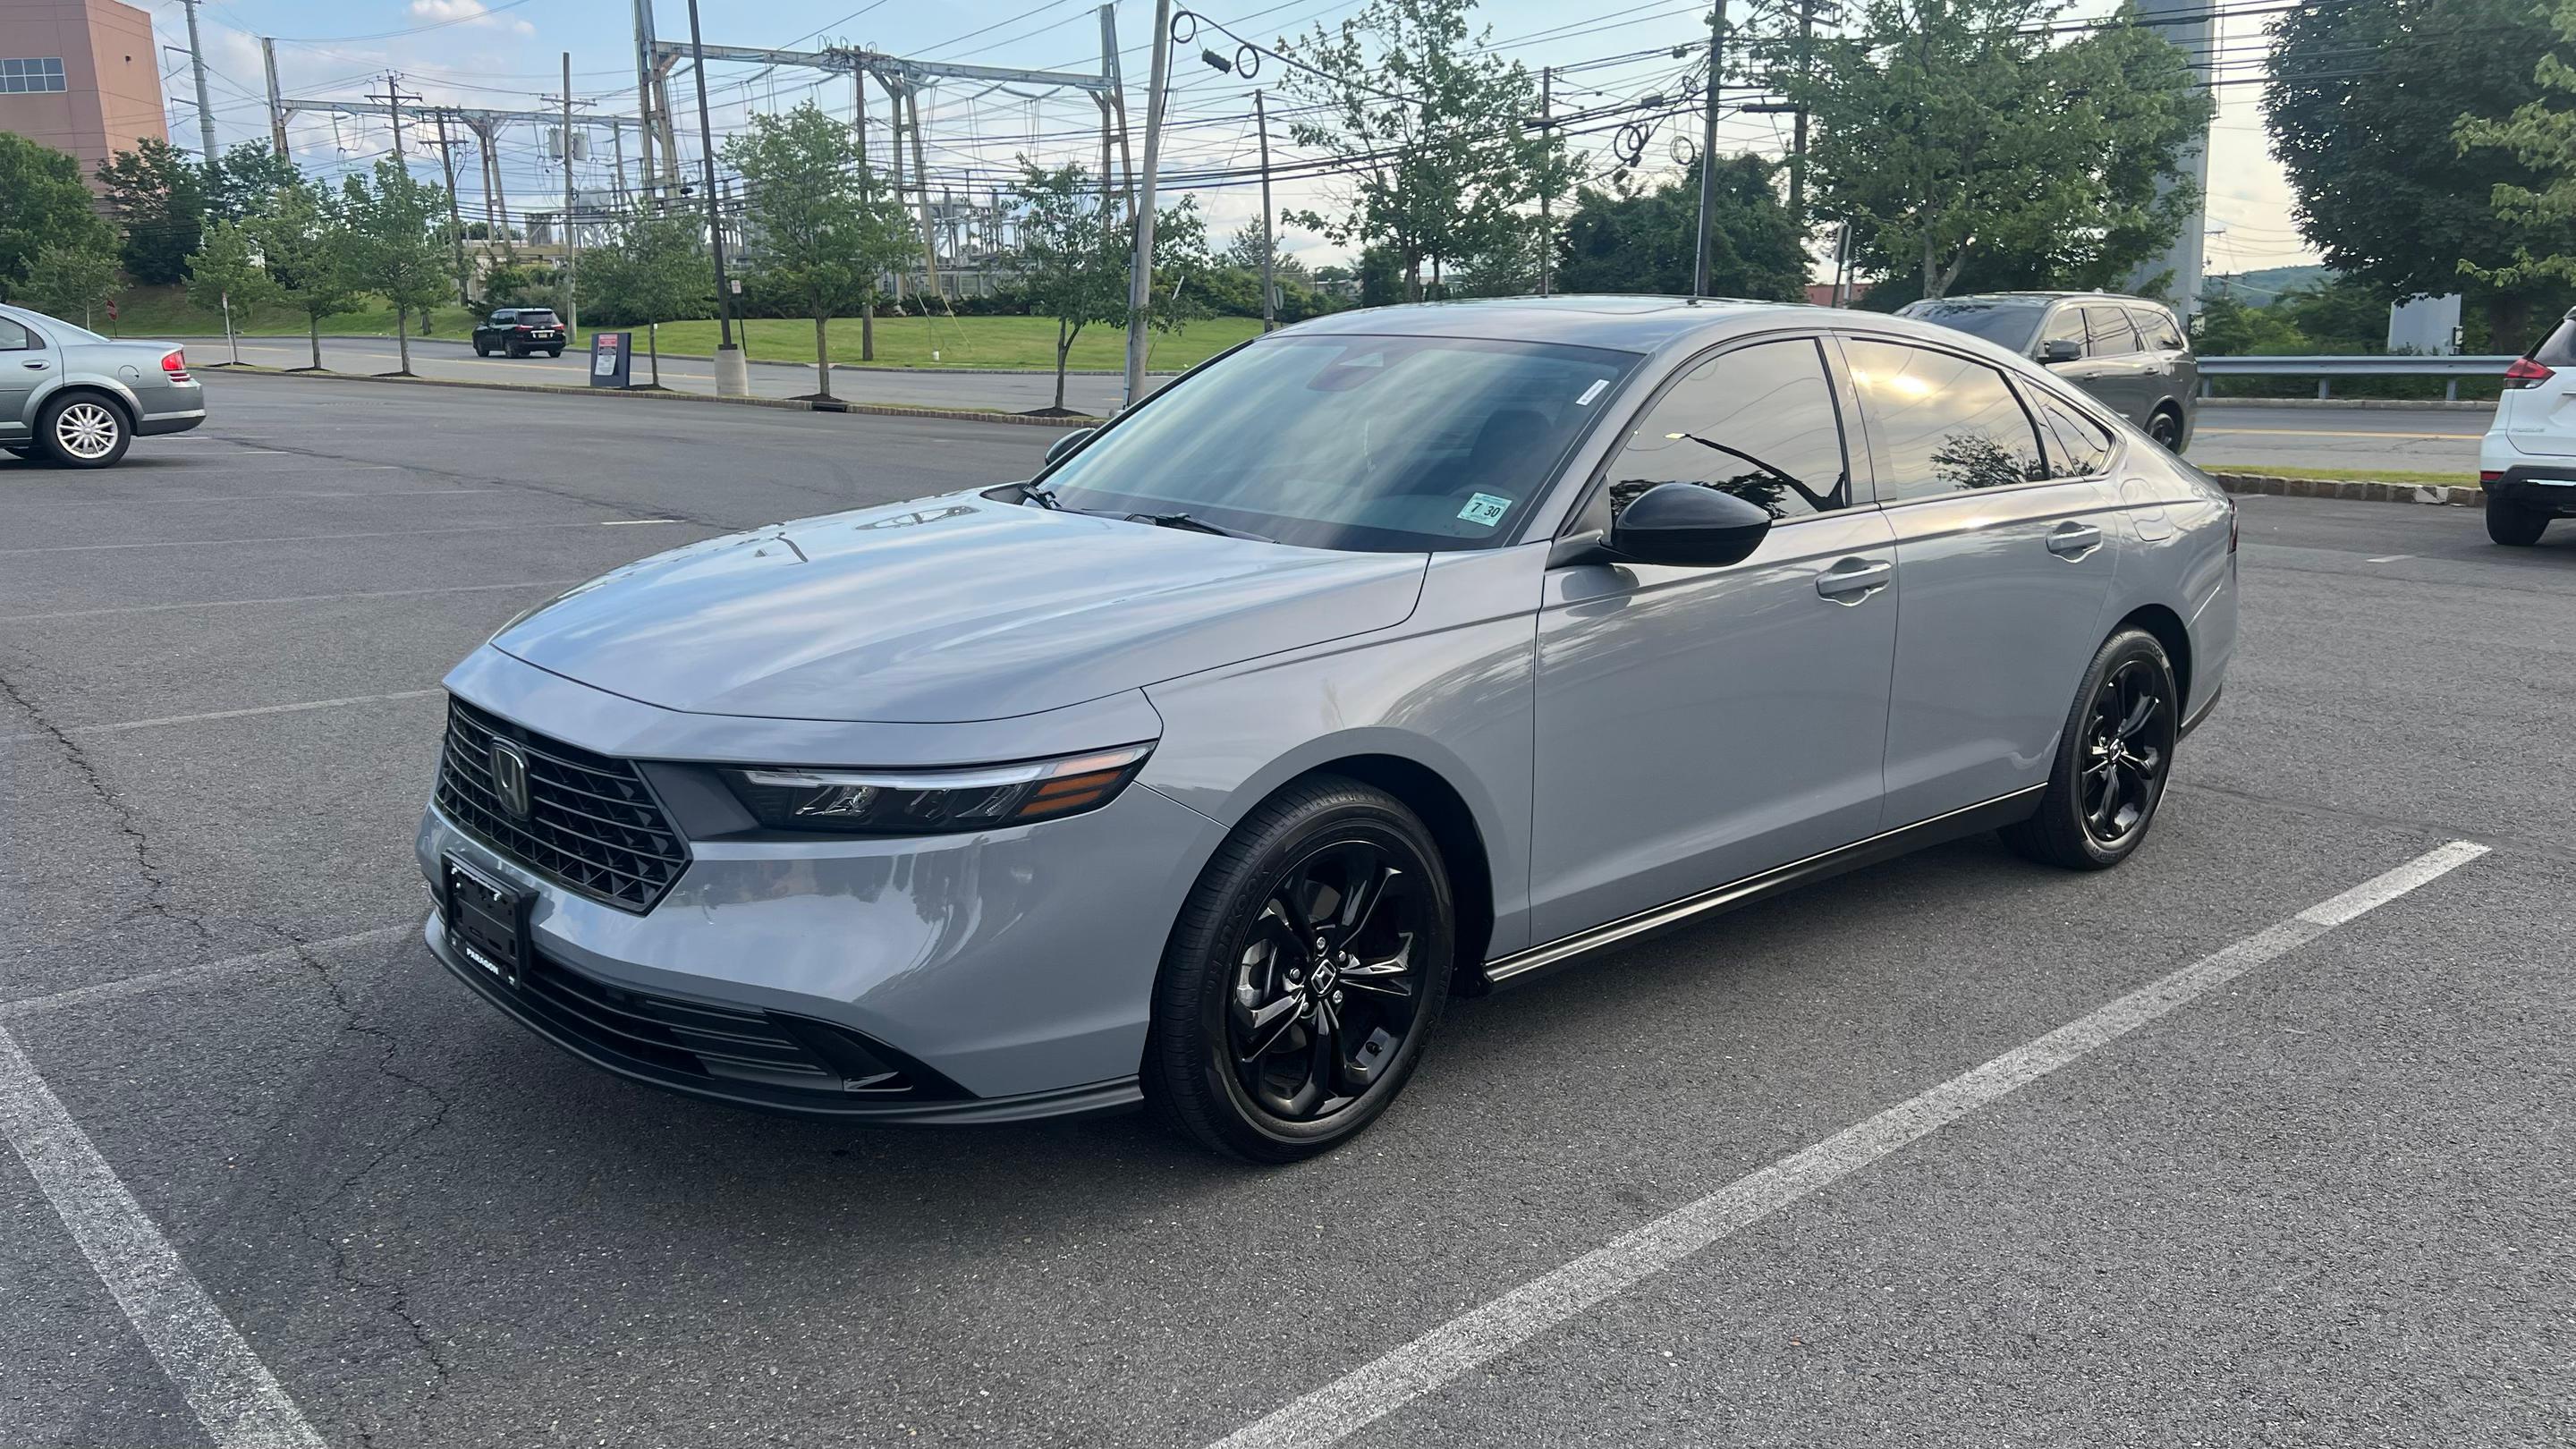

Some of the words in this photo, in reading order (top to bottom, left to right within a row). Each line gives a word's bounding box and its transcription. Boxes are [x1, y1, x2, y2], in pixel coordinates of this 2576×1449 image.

[1471, 502, 1482, 513] 7
[1484, 505, 1501, 517] 30
[466, 947, 499, 975] PARAGON
